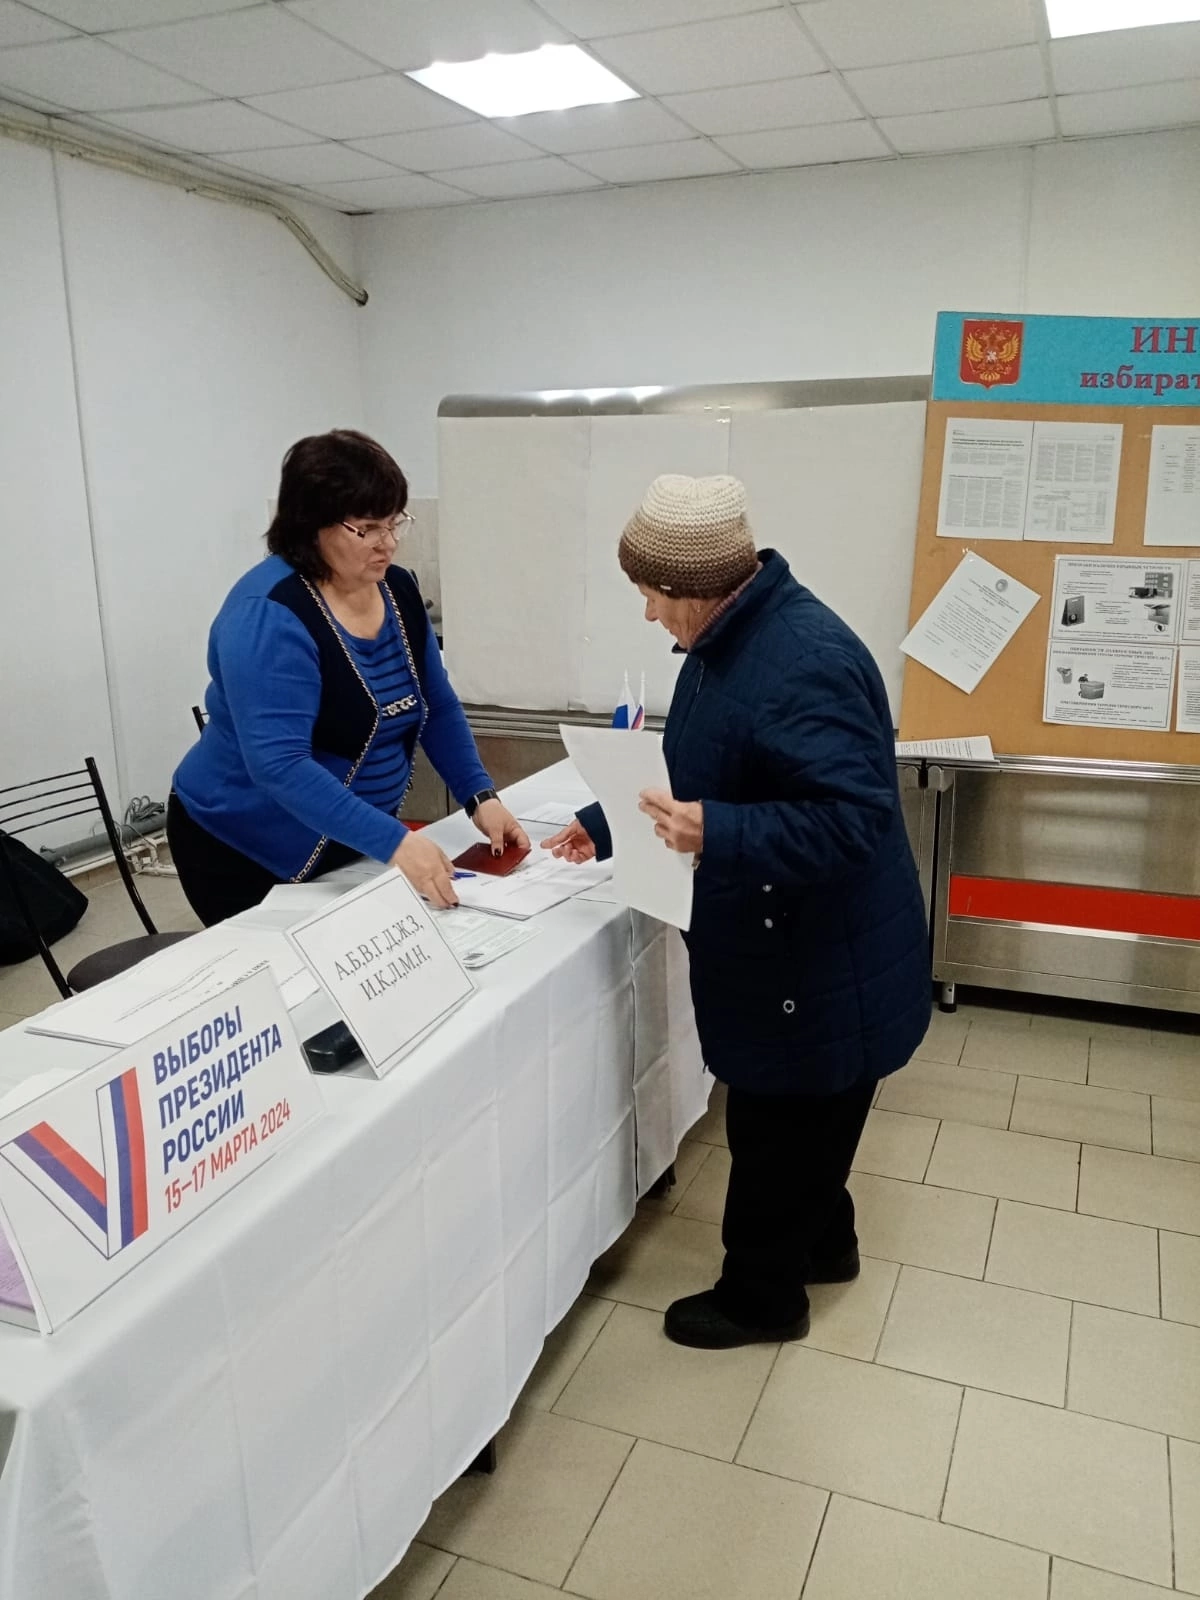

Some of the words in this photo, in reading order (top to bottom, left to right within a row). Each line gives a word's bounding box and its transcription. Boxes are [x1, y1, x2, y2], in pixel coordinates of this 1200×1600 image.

[153, 1005, 242, 1085] ВЫБОРЫ
[158, 1024, 282, 1129] ПРЕЗИДЕНТА
[163, 1089, 244, 1175] РОССИИ
[211, 1122, 258, 1179] МАРТА
[260, 1098, 290, 1140] 2024
